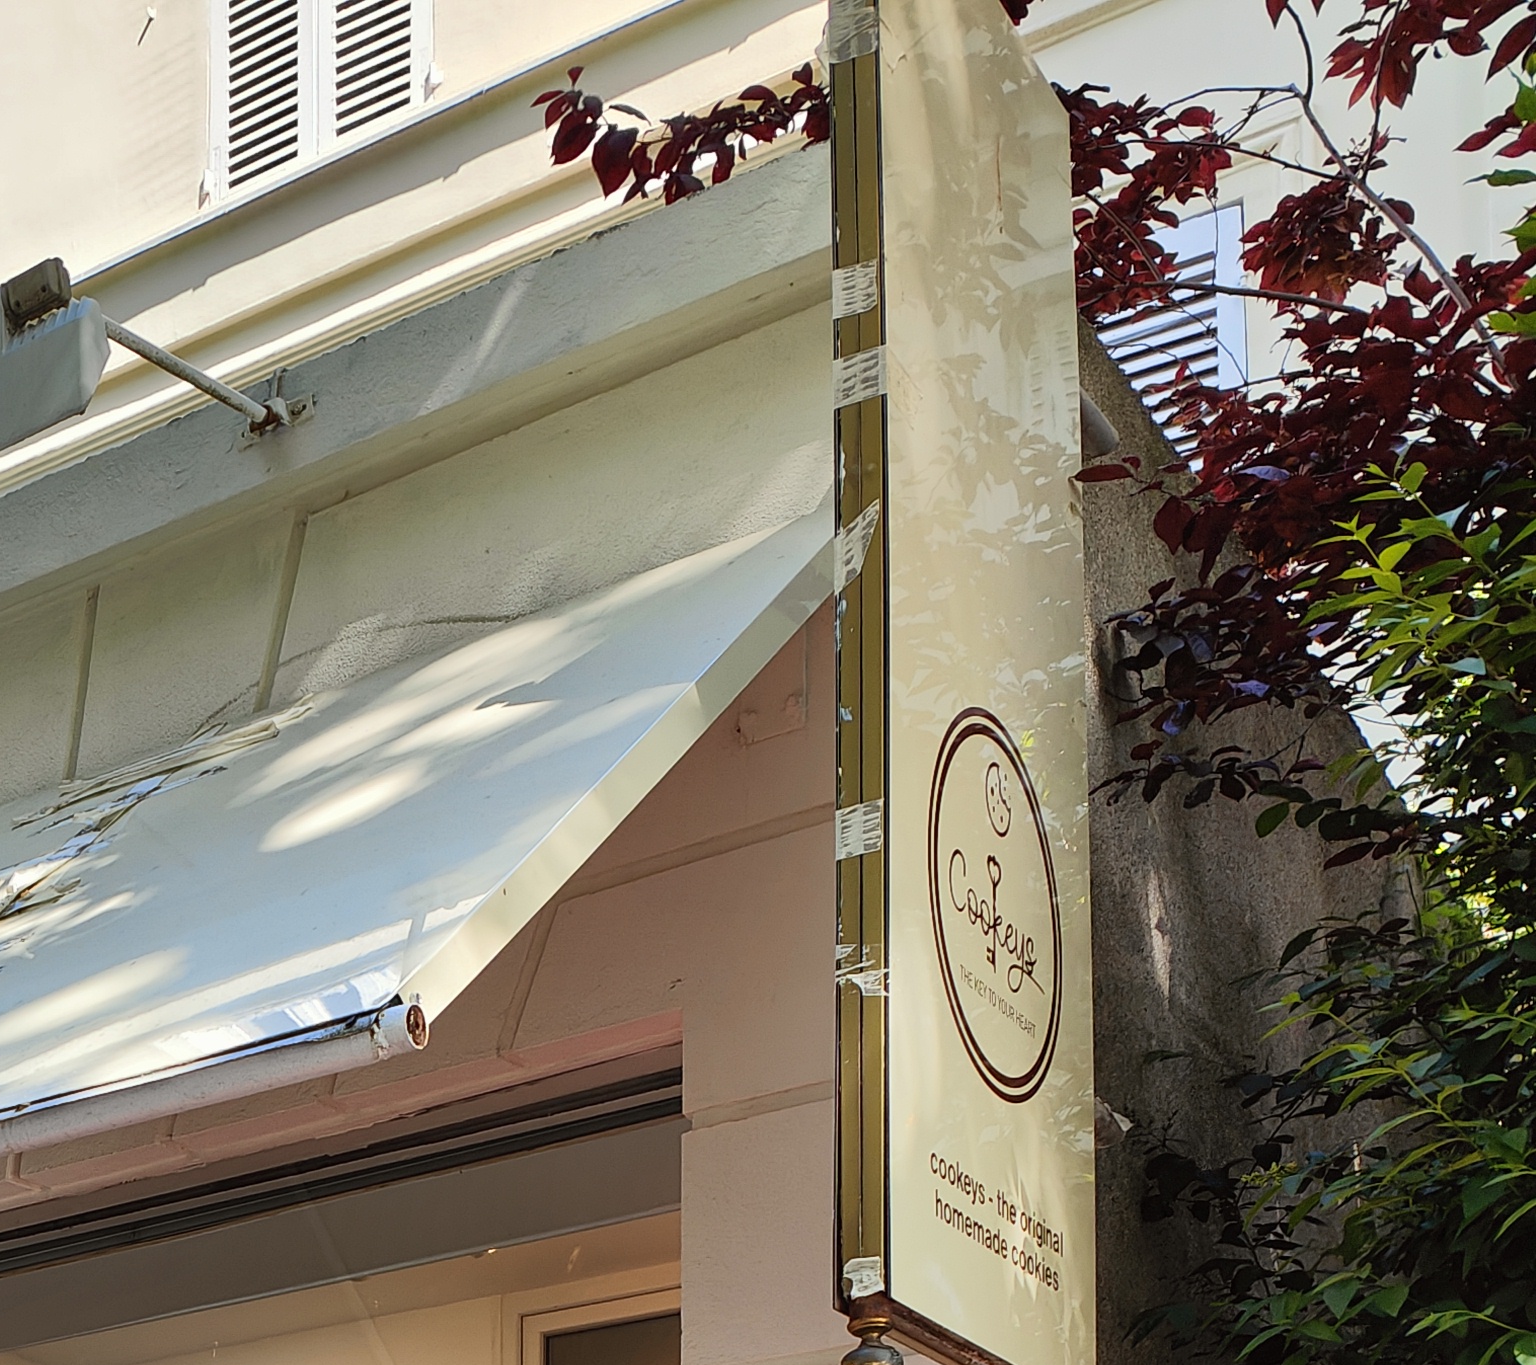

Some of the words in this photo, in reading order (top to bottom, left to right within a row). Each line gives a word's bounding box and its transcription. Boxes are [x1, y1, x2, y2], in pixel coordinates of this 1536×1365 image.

[949, 849, 1046, 995] Cookeys
[960, 964, 974, 989] THE
[974, 976, 988, 998] KEY
[988, 988, 997, 1008] TO
[997, 994, 1015, 1023] YOUR
[1015, 1010, 1036, 1039] HEART
[930, 1152, 985, 1205] cookeys
[997, 1190, 1017, 1225] the
[1020, 1211, 1064, 1258] original
[935, 1189, 1008, 1259] homemade
[1012, 1245, 1059, 1291] cookies
